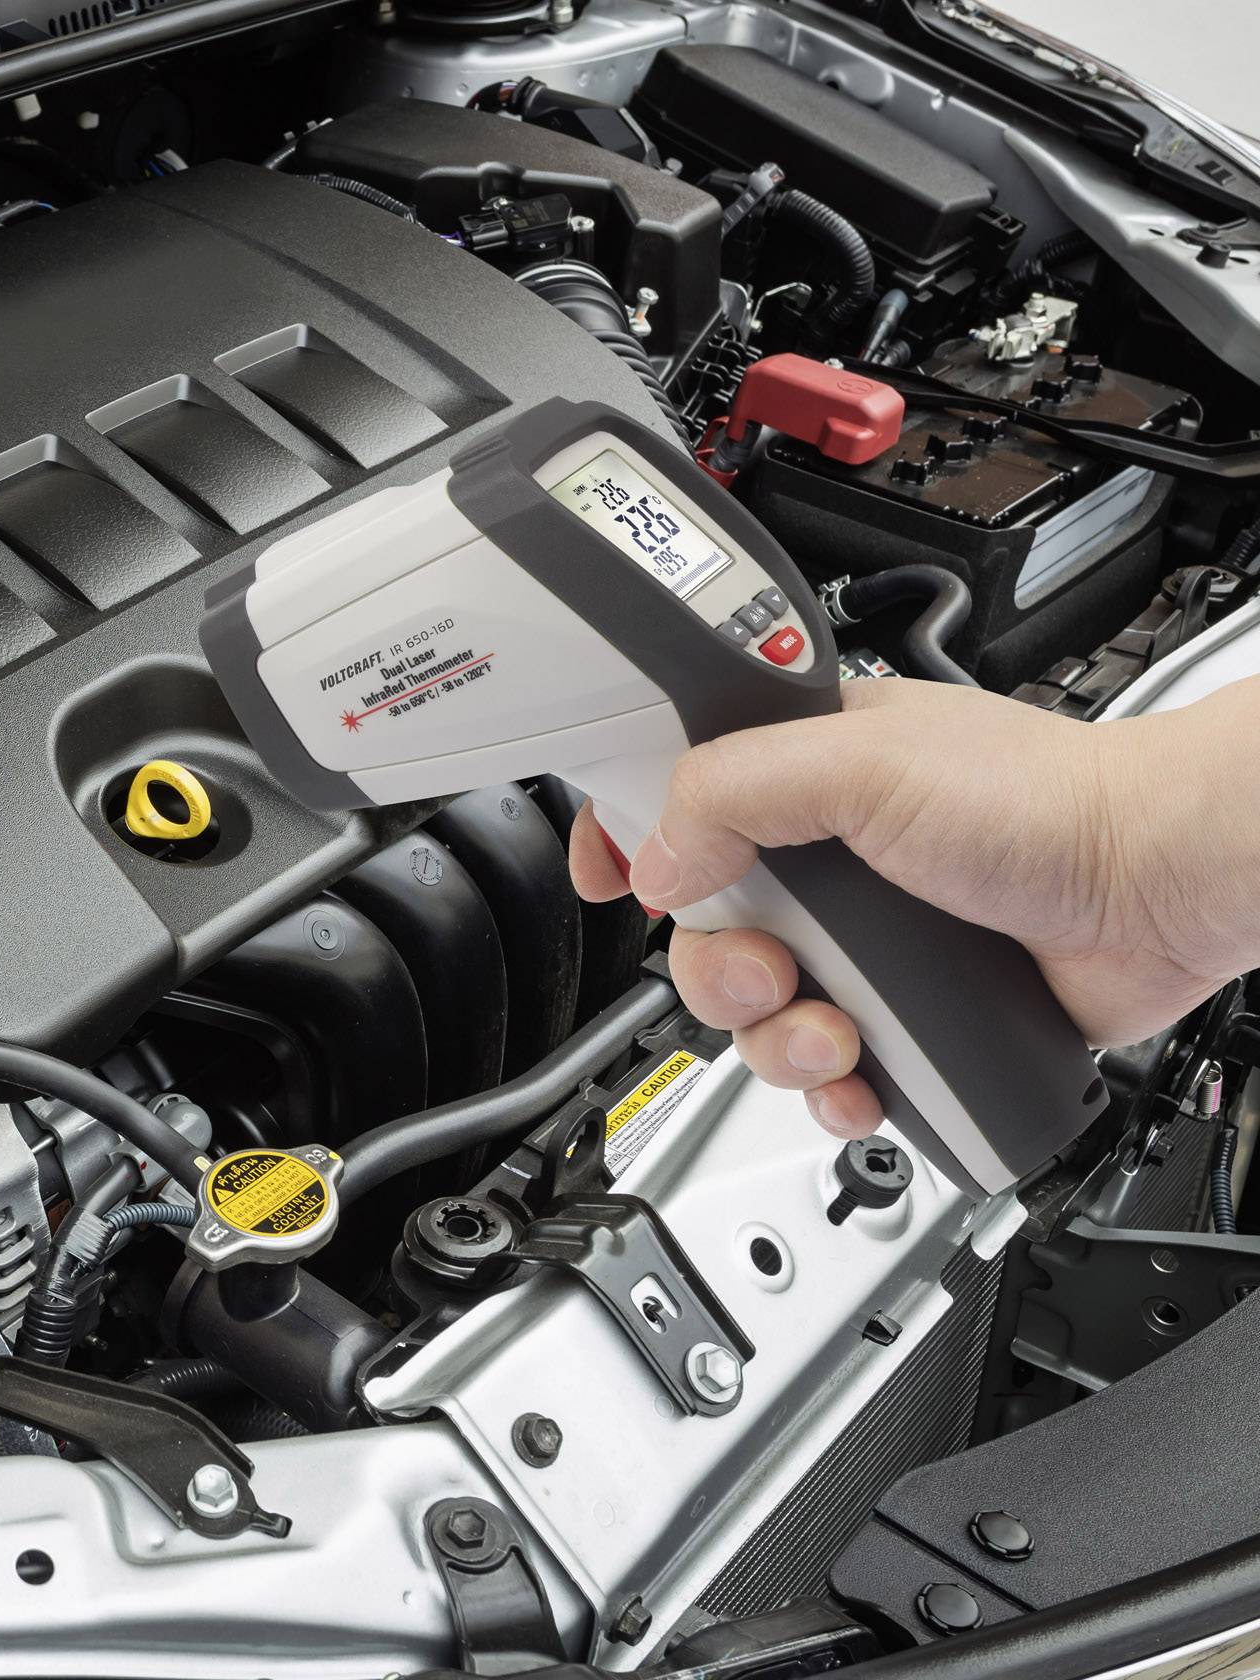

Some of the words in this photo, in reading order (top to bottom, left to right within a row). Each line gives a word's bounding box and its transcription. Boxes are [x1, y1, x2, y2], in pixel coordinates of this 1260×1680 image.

[390, 644, 404, 657] IR
[405, 618, 455, 649] 650-16D
[779, 634, 798, 650] MODE
[361, 680, 406, 709] InfraRed
[405, 648, 475, 687] Thermometer
[380, 660, 406, 680] Dual
[407, 647, 438, 669] Laser
[388, 705, 401, 718] -50
[400, 701, 410, 712] to
[409, 688, 436, 708] 650°C
[440, 680, 454, 694] -58
[453, 676, 464, 687] to
[462, 661, 492, 683] 1202°F
[641, 1057, 690, 1097] CAUTION
[217, 1157, 258, 1186] คำเตือน
[232, 1157, 277, 1190] CAUTION
[235, 1204, 255, 1219] NEVER
[254, 1192, 272, 1206] OPEN
[270, 1181, 290, 1197] WHEN
[268, 1192, 310, 1222] ENGINE
[272, 1194, 321, 1230] COOLANT
